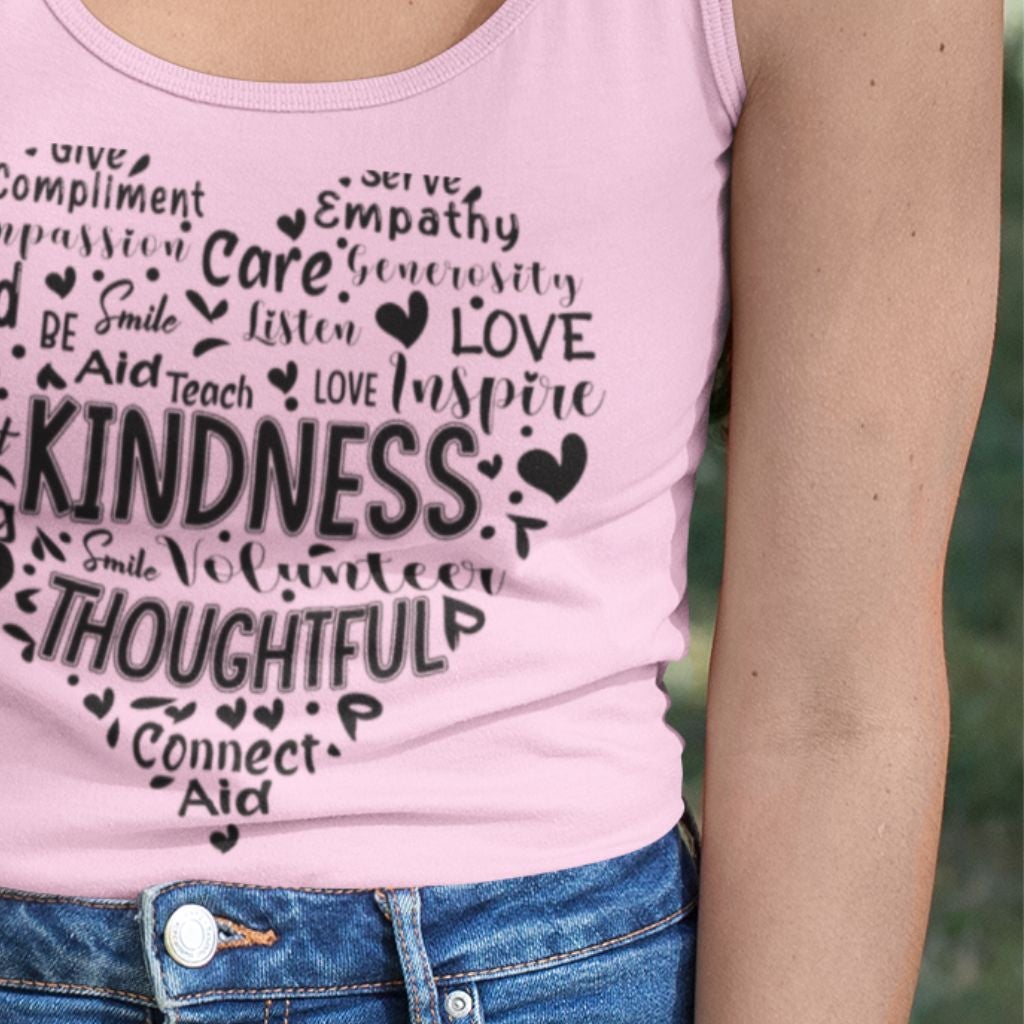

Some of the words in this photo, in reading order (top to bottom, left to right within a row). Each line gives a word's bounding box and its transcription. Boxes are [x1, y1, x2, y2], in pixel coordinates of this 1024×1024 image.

[314, 190, 520, 252] Empathy
[202, 229, 333, 297] Care
[347, 244, 583, 308] Generosity
[40, 310, 78, 352] BE
[95, 278, 182, 335] Smile
[243, 300, 362, 346] Listen
[451, 307, 596, 362] LOVE
[74, 349, 163, 388] Aid
[166, 371, 254, 410] Teach
[315, 368, 378, 406] LOVE
[389, 351, 606, 436] Inspire
[20, 393, 482, 541] KINDNESS
[83, 529, 162, 581] Smile
[155, 534, 506, 596] Volunteer
[37, 571, 448, 694] THOUGHTFUL
[132, 721, 320, 776] Connect
[178, 778, 273, 817] Aid
